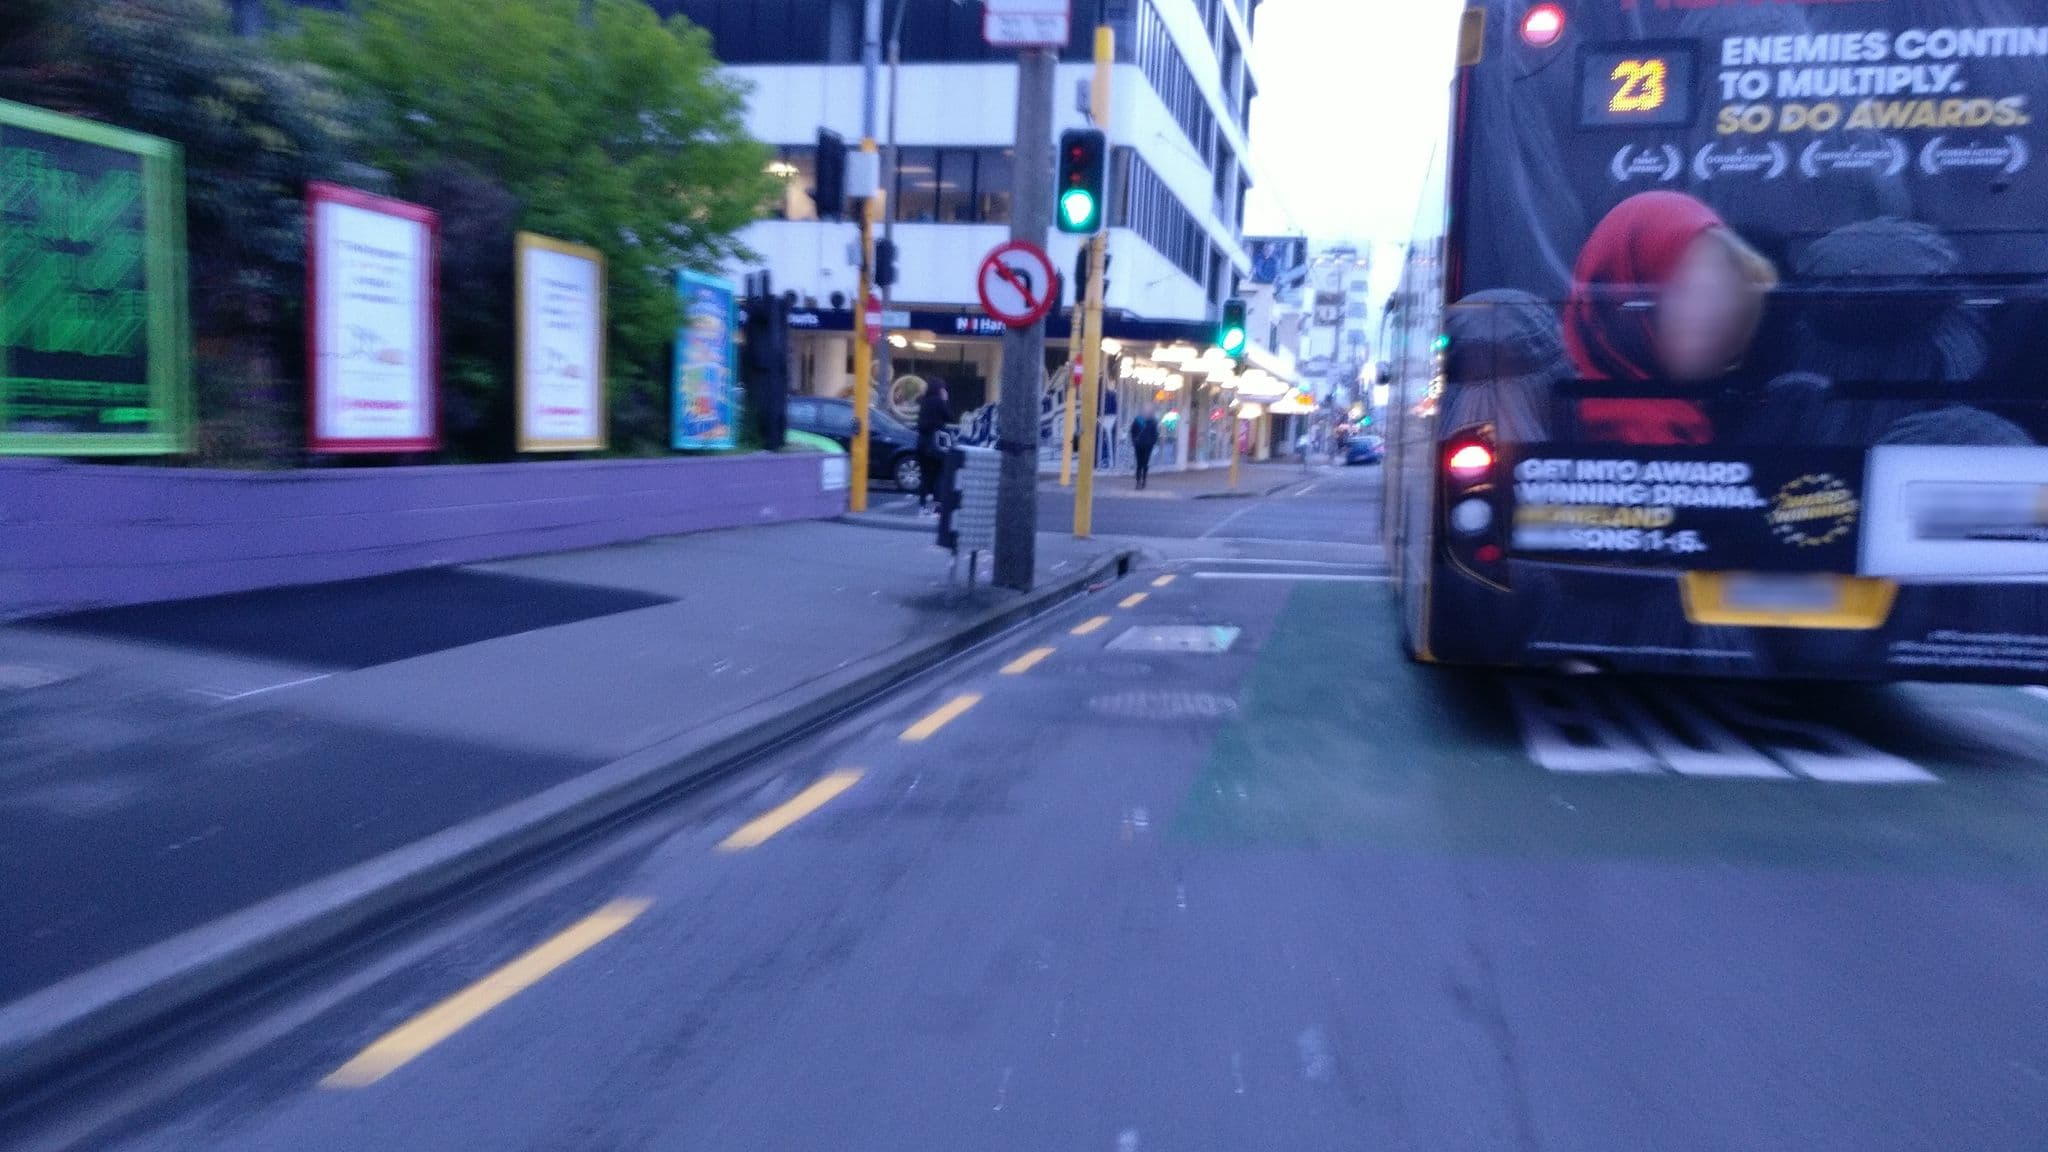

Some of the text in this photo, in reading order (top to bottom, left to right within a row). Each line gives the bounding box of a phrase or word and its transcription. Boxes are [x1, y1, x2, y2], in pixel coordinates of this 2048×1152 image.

[1720, 27, 2048, 66] ENEMIES CONTIN
[1609, 59, 1666, 112] 23
[1719, 64, 1964, 100] TO MULTIPLY.
[1716, 97, 2031, 134] SO DO AWARDS.
[1514, 458, 1752, 484] GET INTO AWARD
[1513, 481, 1768, 509] WINNING DRAMA.
[1506, 682, 1946, 784] BUS
